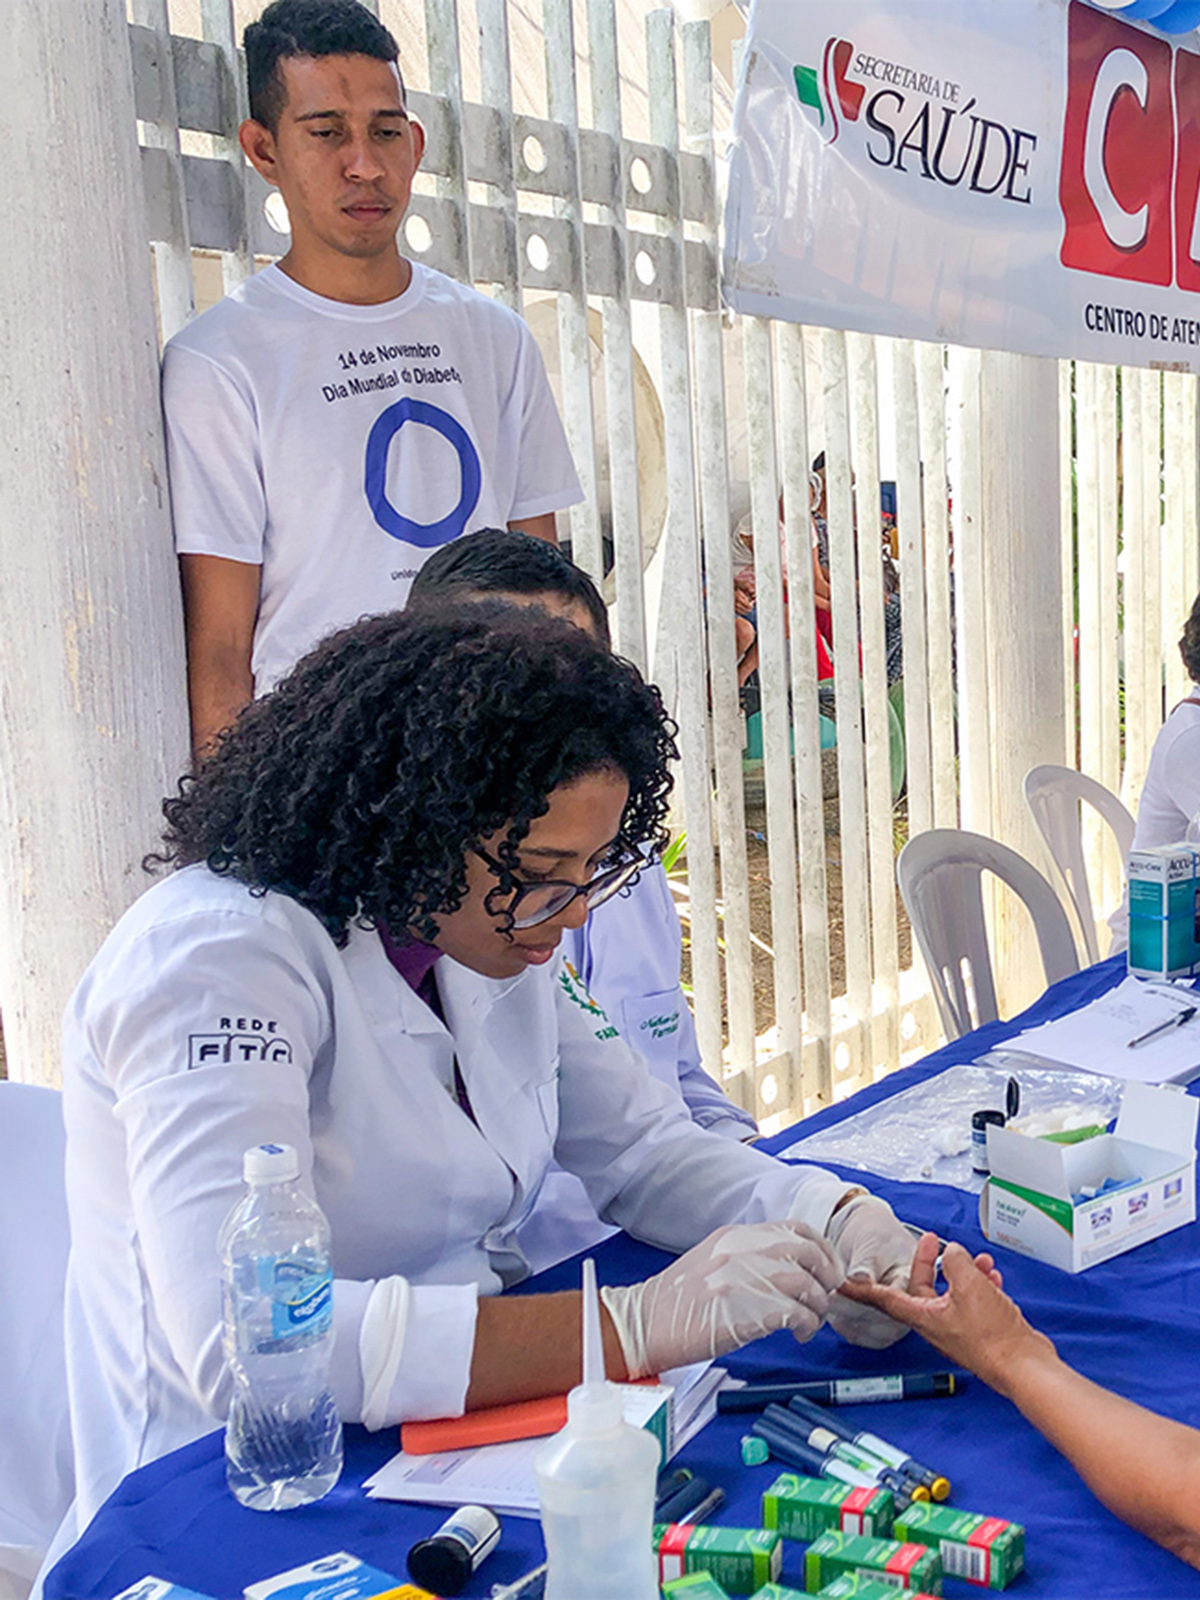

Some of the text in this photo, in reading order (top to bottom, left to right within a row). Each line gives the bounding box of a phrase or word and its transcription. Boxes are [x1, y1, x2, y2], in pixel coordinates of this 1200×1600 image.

[854, 53, 960, 103] SECRETARIA DE
[866, 89, 1037, 203] SAÚDE
[1085, 304, 1146, 337] CENTRO
[1150, 316, 1168, 341] DE
[338, 343, 440, 369] 14 de Novembro
[322, 384, 348, 402] Dia
[347, 370, 399, 395] Mundial
[220, 1018, 277, 1033] REDE
